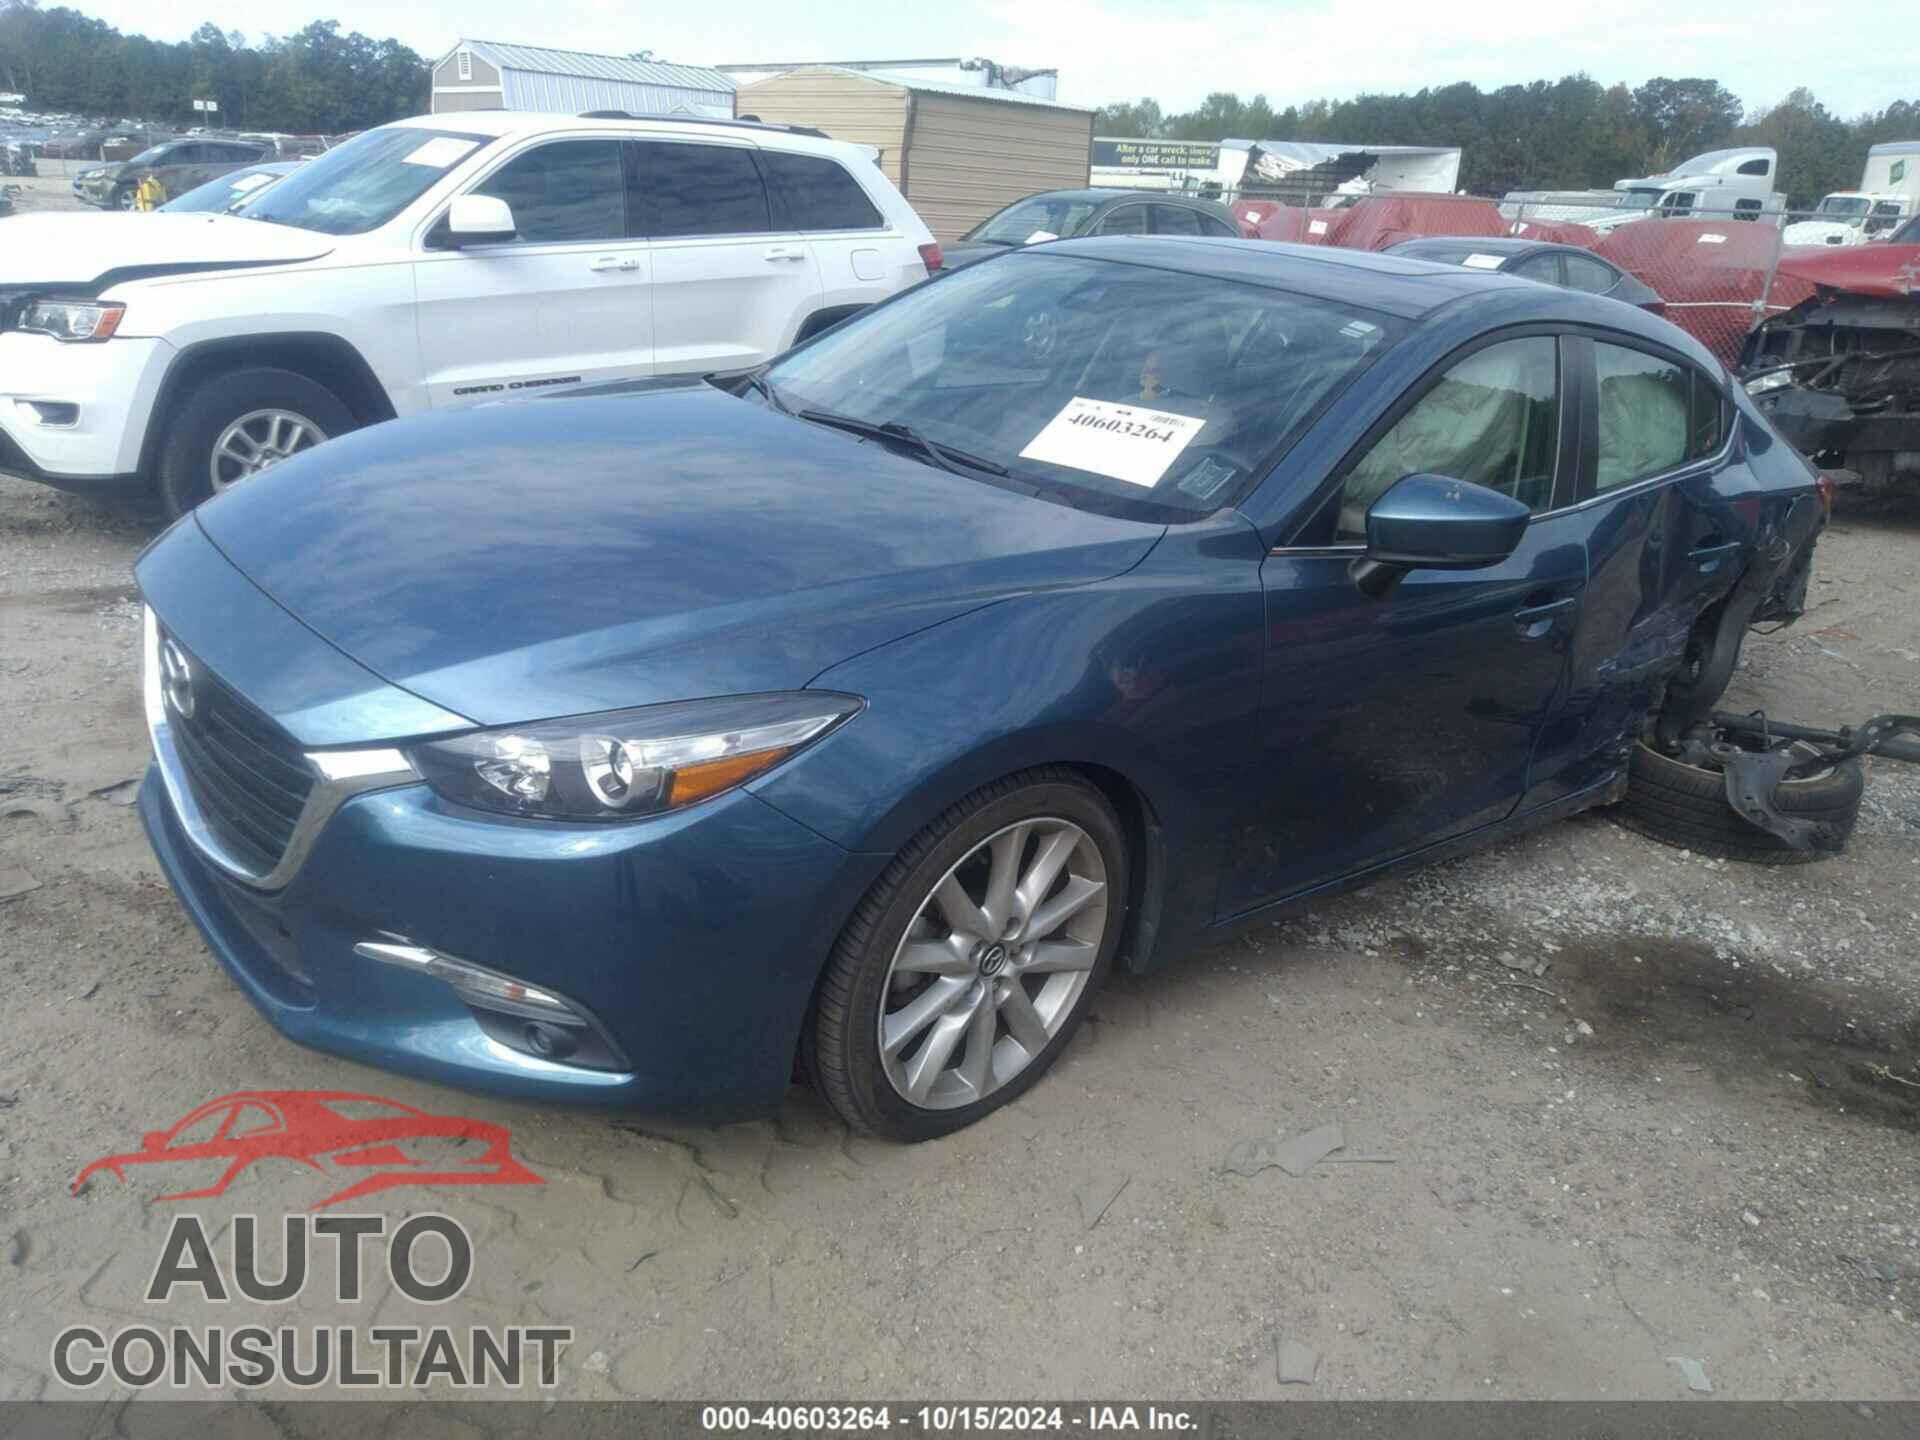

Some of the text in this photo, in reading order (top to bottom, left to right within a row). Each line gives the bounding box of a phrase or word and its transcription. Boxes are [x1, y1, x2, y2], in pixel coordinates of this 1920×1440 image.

[1115, 143, 1137, 154] After
[1145, 146, 1159, 155] car
[1121, 155, 1140, 165] only
[1141, 155, 1160, 165] ONE
[1161, 156, 1176, 165] call
[453, 375, 581, 395] GRAND CHEROKEE
[1068, 413, 1175, 443] 40603264
